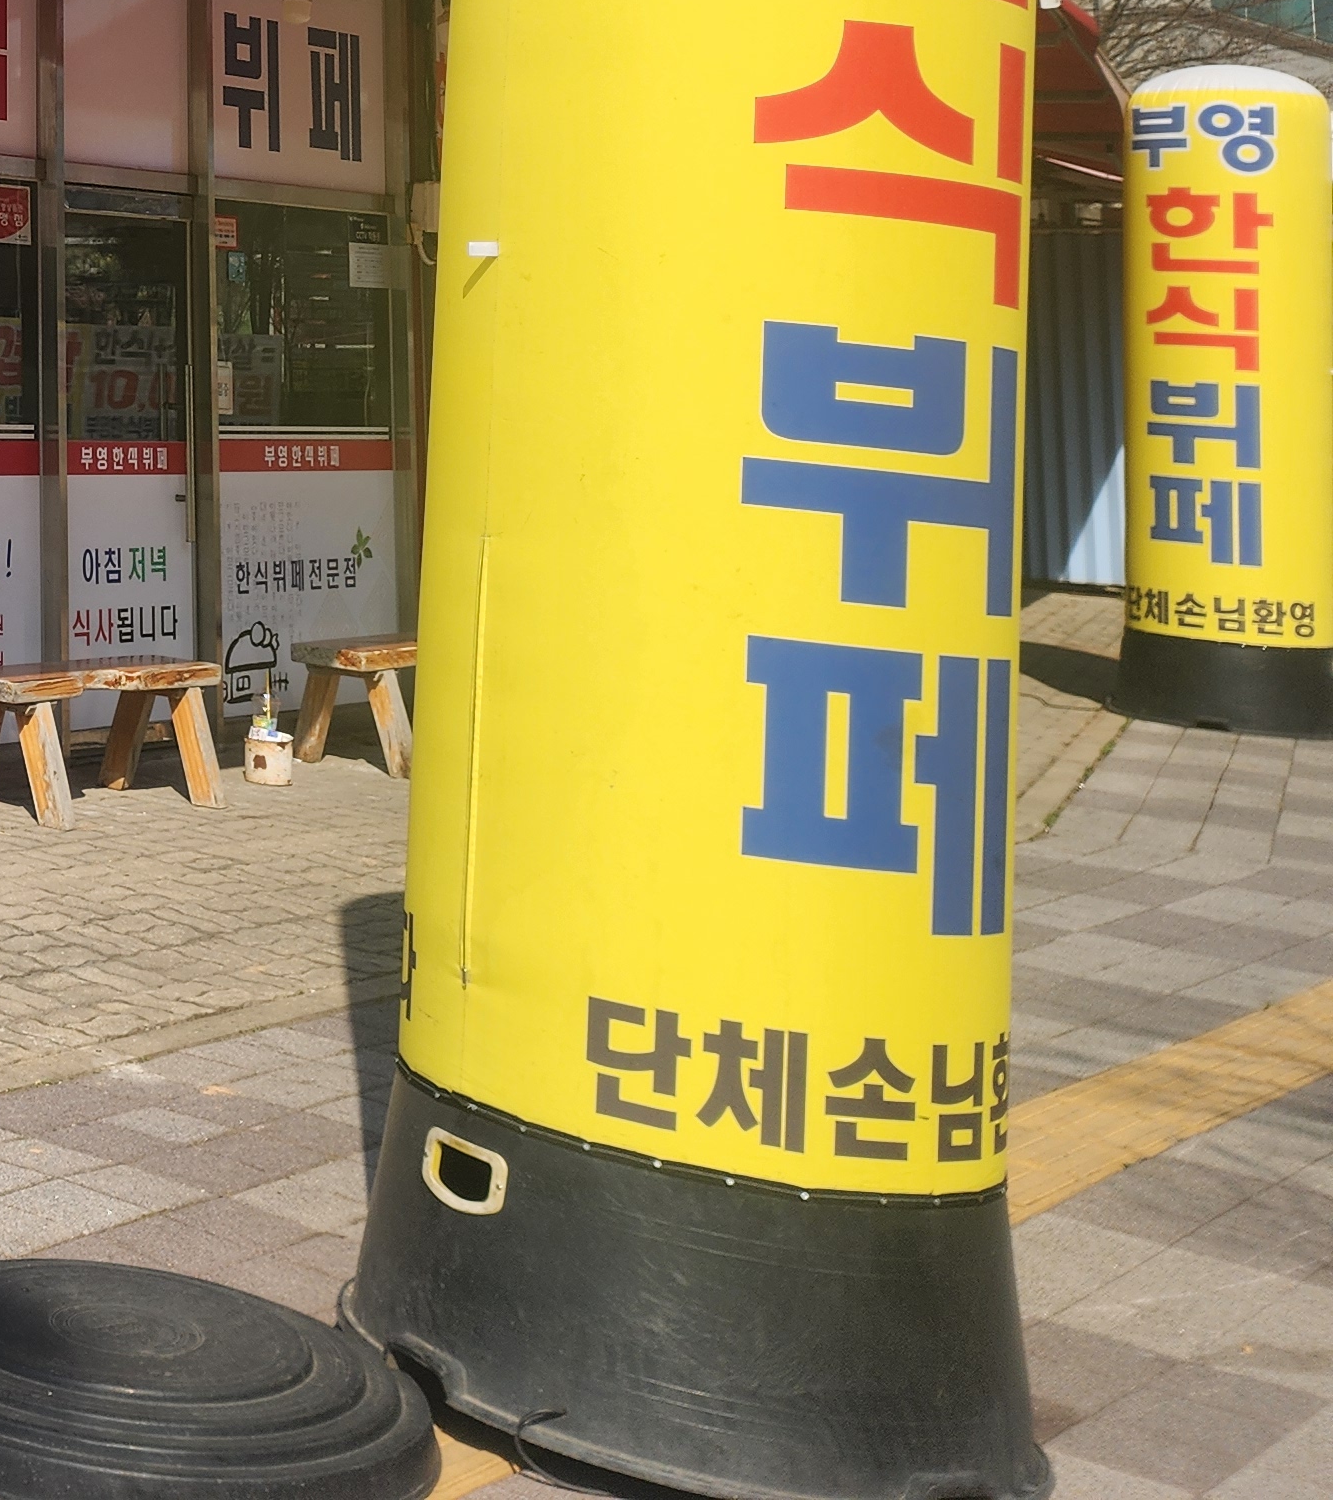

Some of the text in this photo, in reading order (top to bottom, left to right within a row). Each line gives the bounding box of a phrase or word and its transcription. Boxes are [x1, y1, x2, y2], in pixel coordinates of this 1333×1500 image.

[223, 11, 363, 164] 뷔페
[1130, 103, 1275, 173] 부영
[82, 545, 169, 586] 아침 저녁
[72, 603, 179, 647] 식사됩니다
